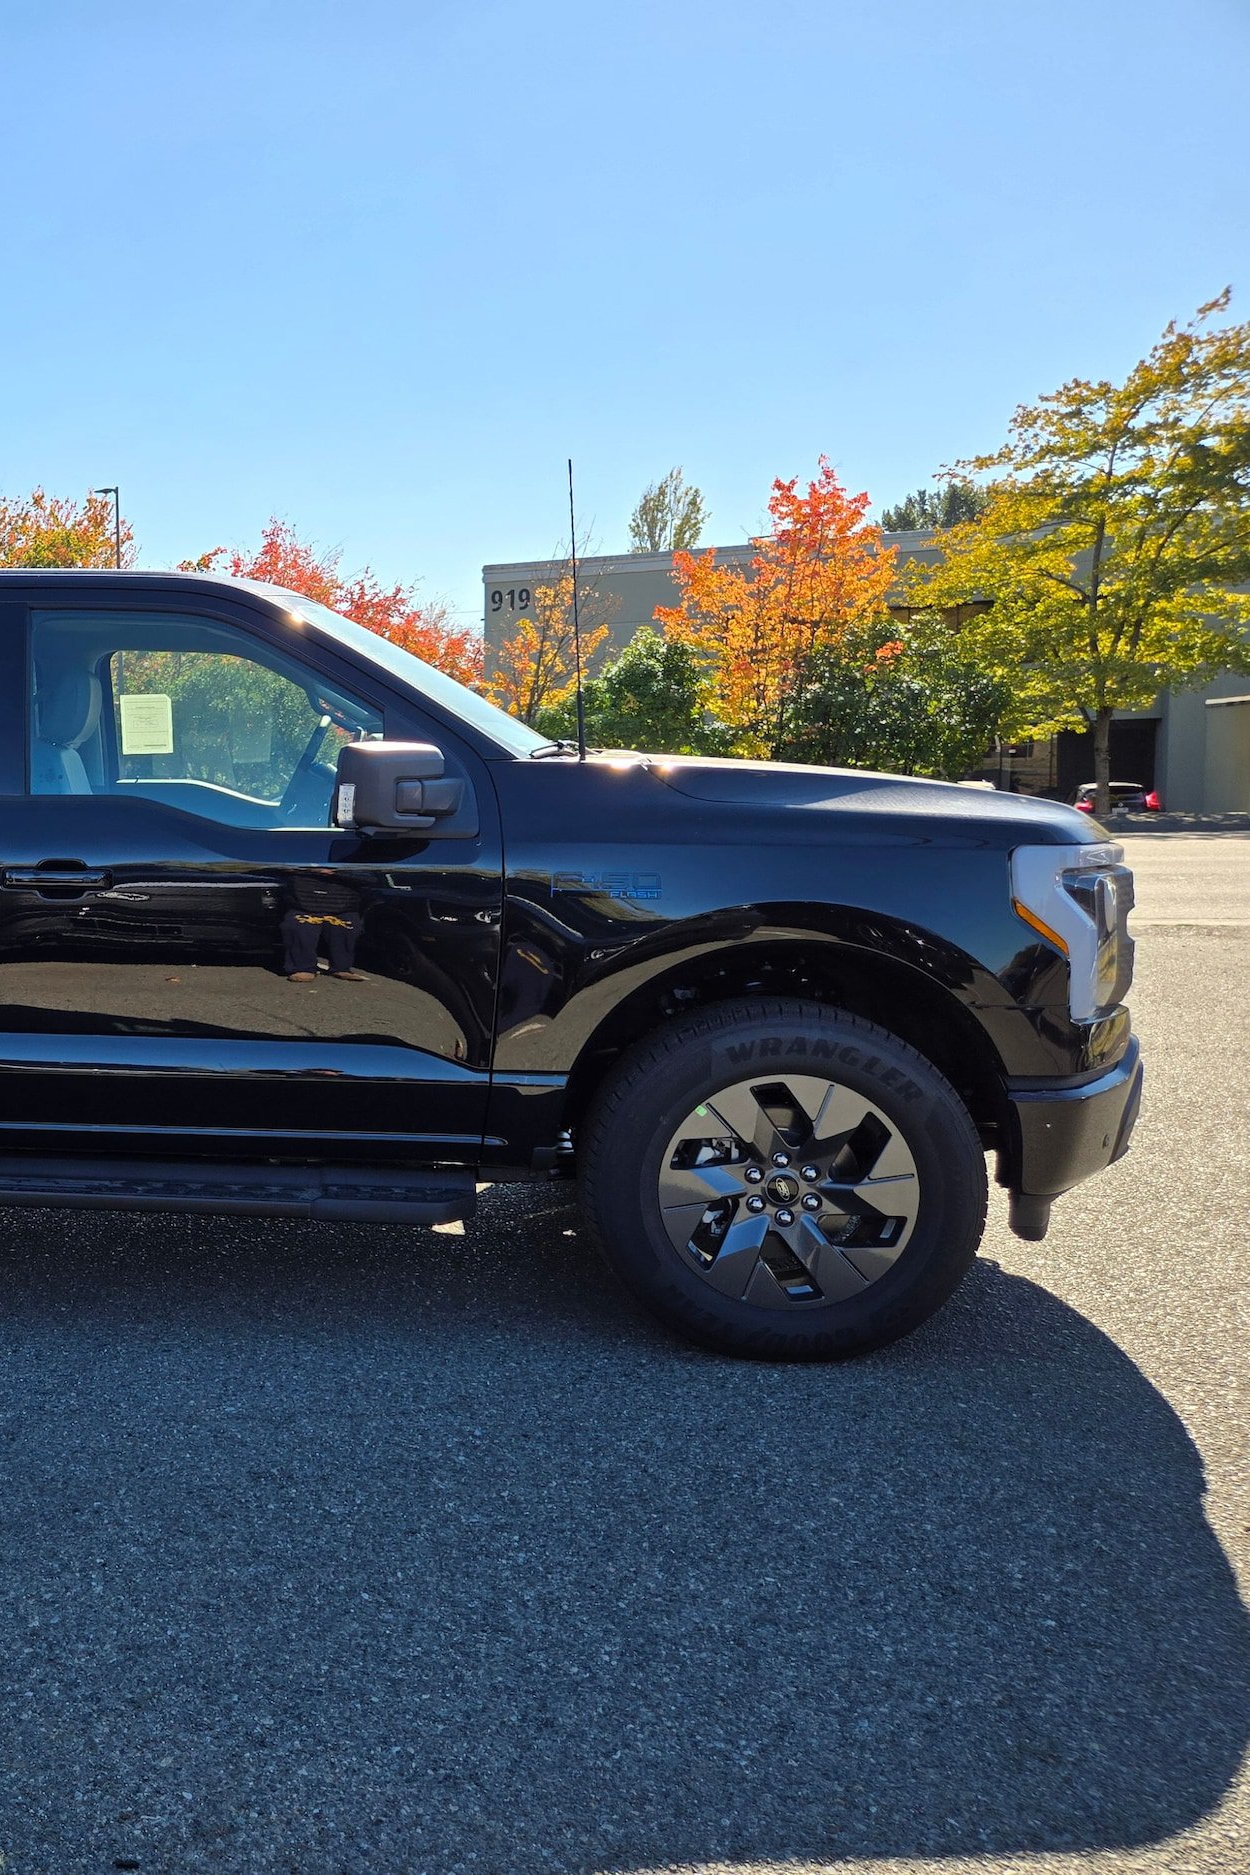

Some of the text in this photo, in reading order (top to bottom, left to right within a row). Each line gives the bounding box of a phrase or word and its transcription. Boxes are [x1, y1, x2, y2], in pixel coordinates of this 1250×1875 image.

[490, 588, 531, 612] 919
[610, 890, 658, 899] FLASH
[726, 1036, 924, 1102] WRANGLER
